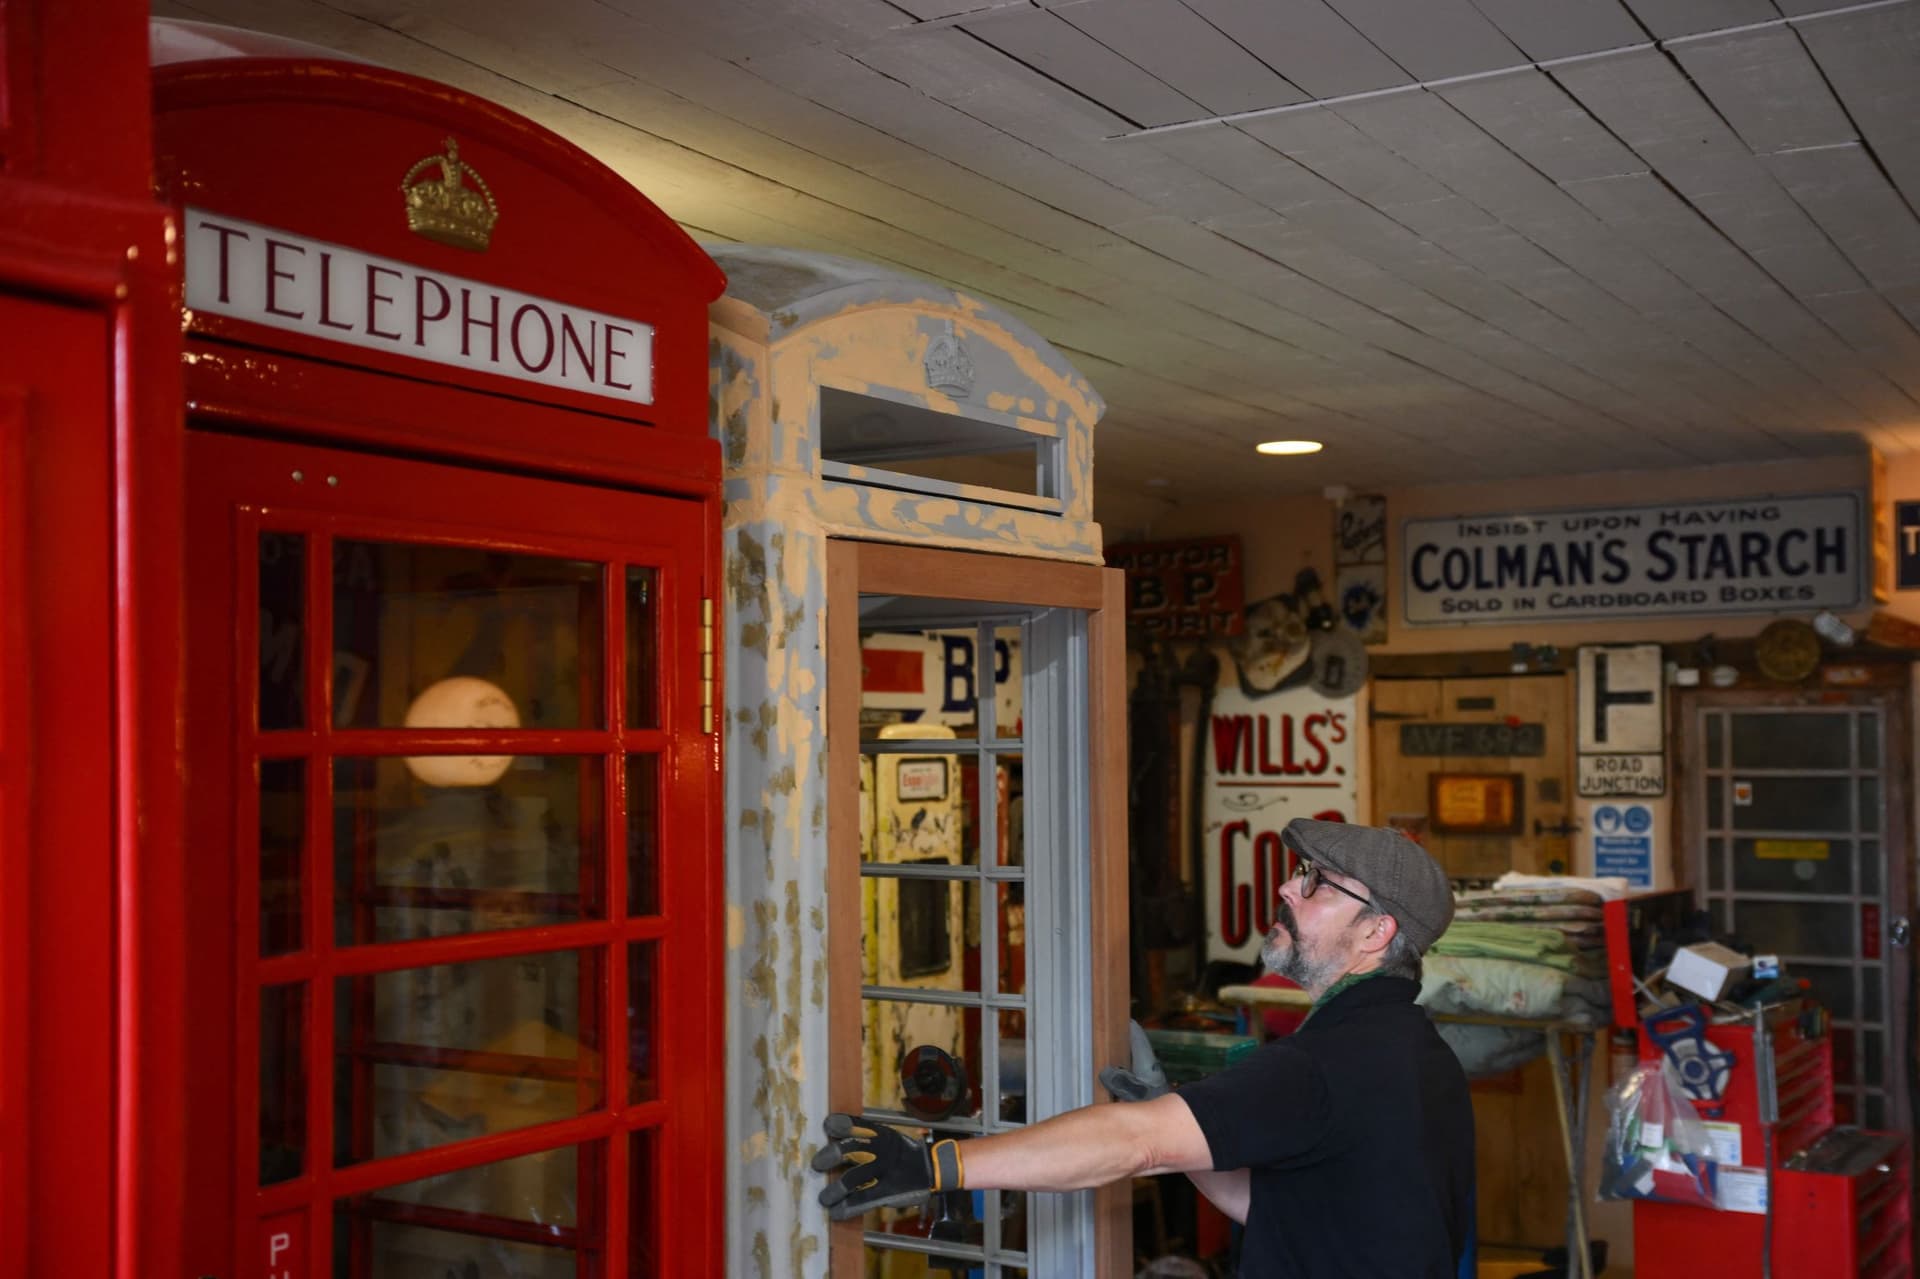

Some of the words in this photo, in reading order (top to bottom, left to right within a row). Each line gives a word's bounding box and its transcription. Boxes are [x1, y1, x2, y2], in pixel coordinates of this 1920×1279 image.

[198, 222, 634, 391] TELEPHONE
[1457, 519, 1549, 538] INSIST
[1561, 514, 1643, 532] UPON
[1659, 506, 1782, 527] HAVING
[1411, 532, 1632, 593] COLMAN'S
[1646, 527, 1847, 584] STARCH
[1441, 596, 1503, 615] SOLD
[1513, 595, 1536, 612] IN
[1548, 586, 1708, 610] CARDBOARD
[1719, 584, 1816, 604] BOXES
[1594, 757, 1643, 773] ROAD
[1580, 774, 1664, 792] JUNCTION
